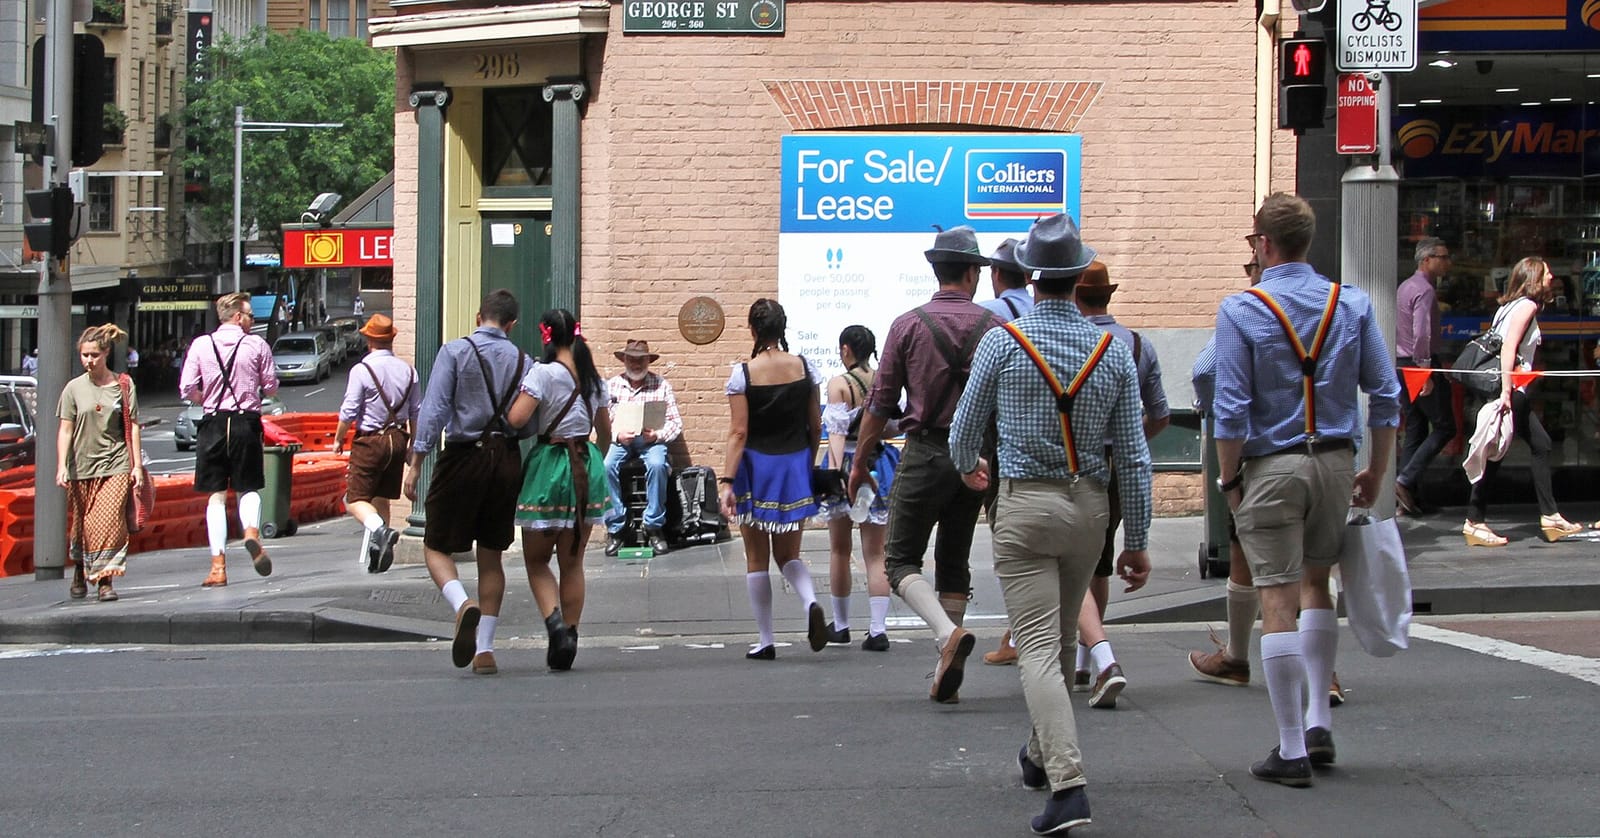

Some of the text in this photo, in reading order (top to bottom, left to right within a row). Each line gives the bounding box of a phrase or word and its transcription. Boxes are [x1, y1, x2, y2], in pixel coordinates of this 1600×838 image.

[628, 2, 705, 18] GEORGE
[716, 2, 738, 18] ST
[661, 20, 677, 29] 296
[688, 20, 704, 29] 360
[1347, 35, 1403, 48] CYCLISTS
[1345, 51, 1406, 63] DISMOUNT
[473, 54, 520, 79] 296
[1348, 79, 1364, 92] NO
[1338, 96, 1376, 107] STOPPING
[1441, 122, 1600, 162] EzyMar
[797, 146, 953, 186] For Sale/
[976, 162, 1056, 184] Colliers
[976, 185, 1056, 194] INTERNATIONAL
[796, 187, 894, 221] Lease
[803, 273, 864, 284] Over 50,000
[143, 284, 208, 293] GRAND HOTEL
[799, 287, 869, 298] people passing
[816, 300, 851, 311] per day
[797, 330, 818, 340] Sale
[798, 346, 831, 355] Jordan
